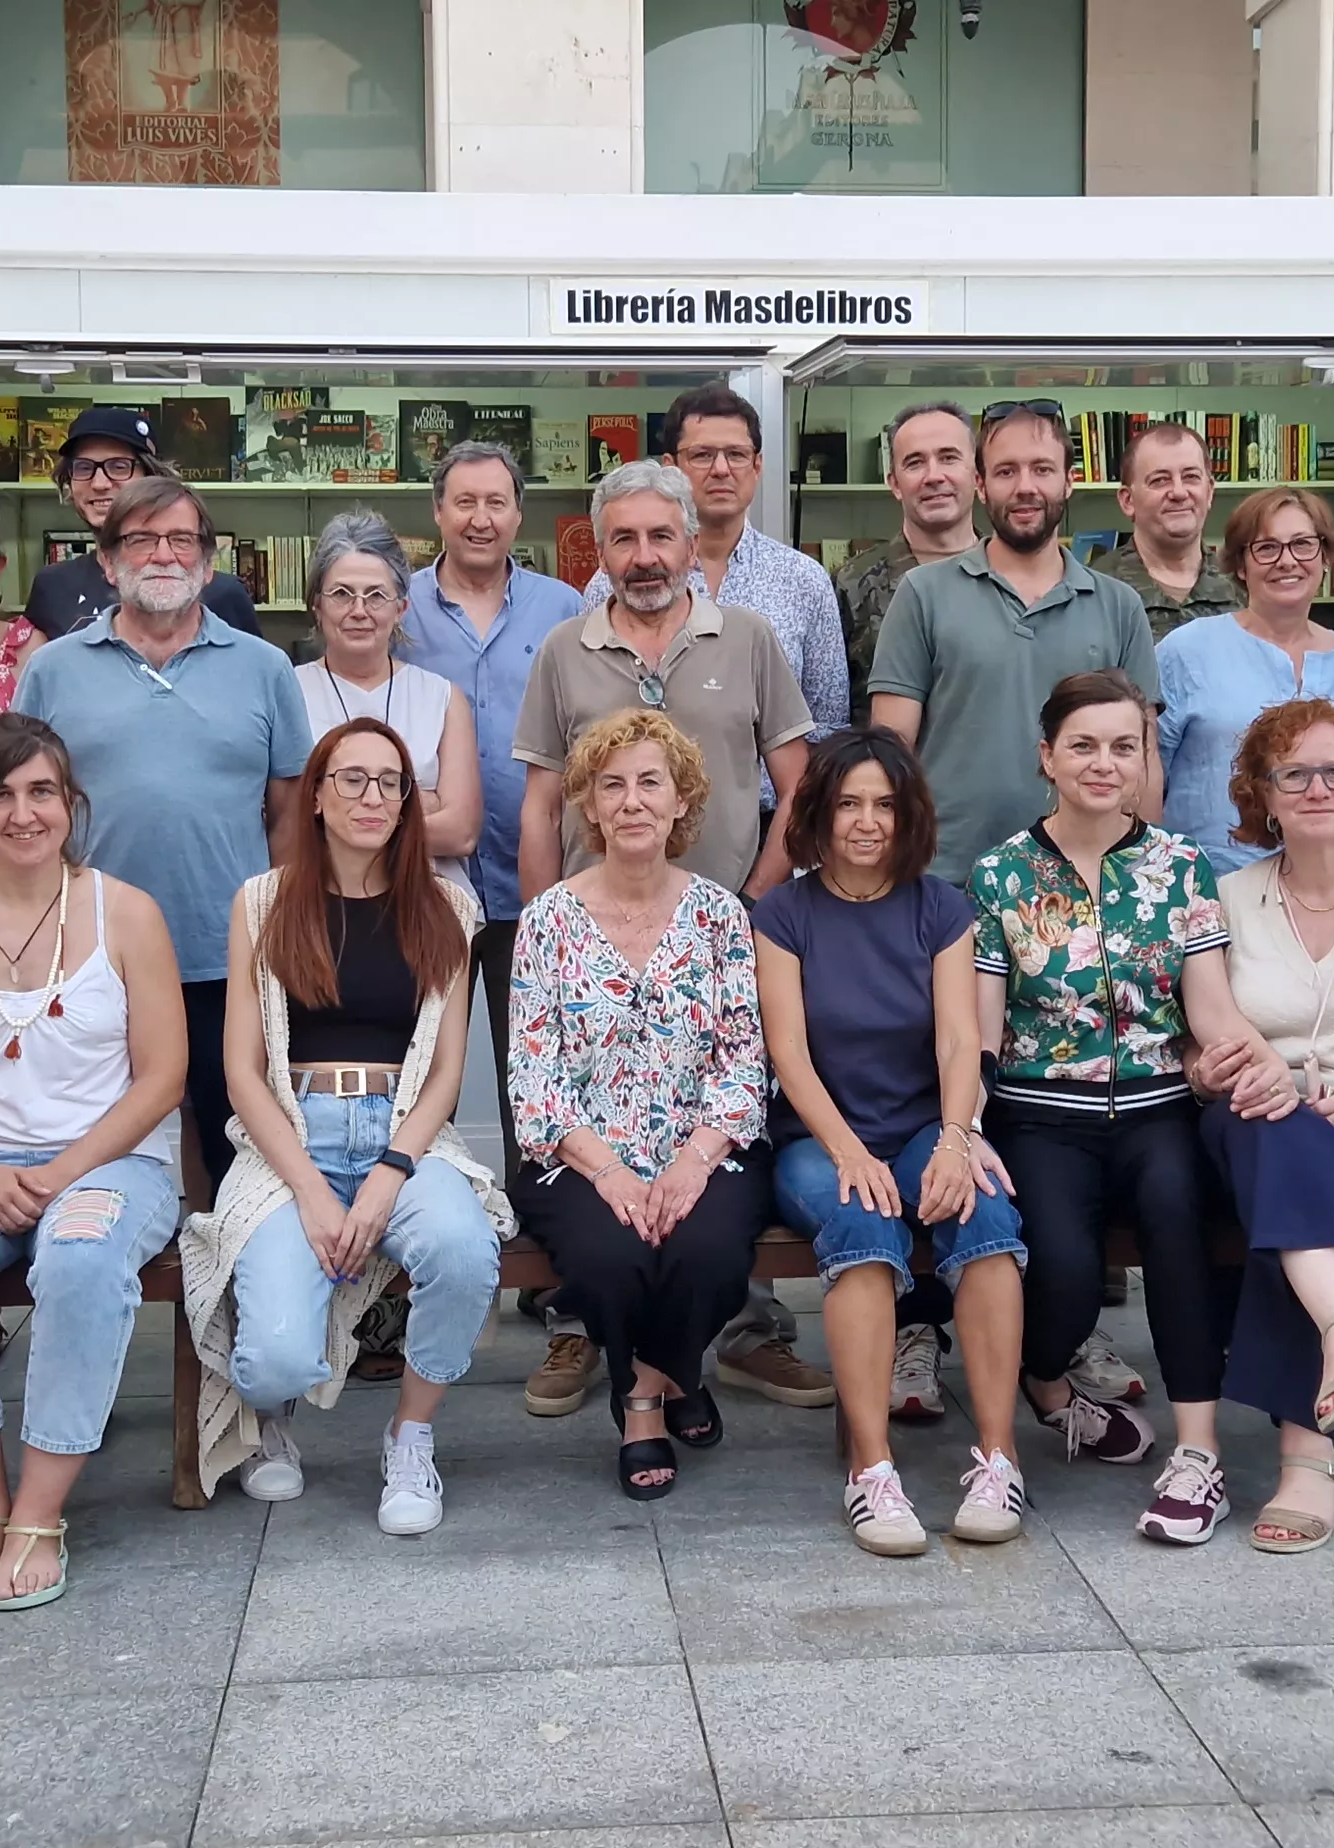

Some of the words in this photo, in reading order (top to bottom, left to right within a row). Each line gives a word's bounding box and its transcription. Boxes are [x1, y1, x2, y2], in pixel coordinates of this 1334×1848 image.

[136, 115, 209, 130] EDITORIAL
[126, 127, 165, 144] LUIS
[167, 128, 217, 146] VIVES
[810, 132, 894, 148] GERONA
[566, 288, 695, 325] Librería
[704, 289, 913, 325] Masdelibros
[333, 414, 354, 424] SACCO
[421, 407, 447, 420] Obra
[413, 415, 455, 433] Maestra
[535, 436, 581, 451] Sapiens
[179, 467, 226, 480] ERVET
